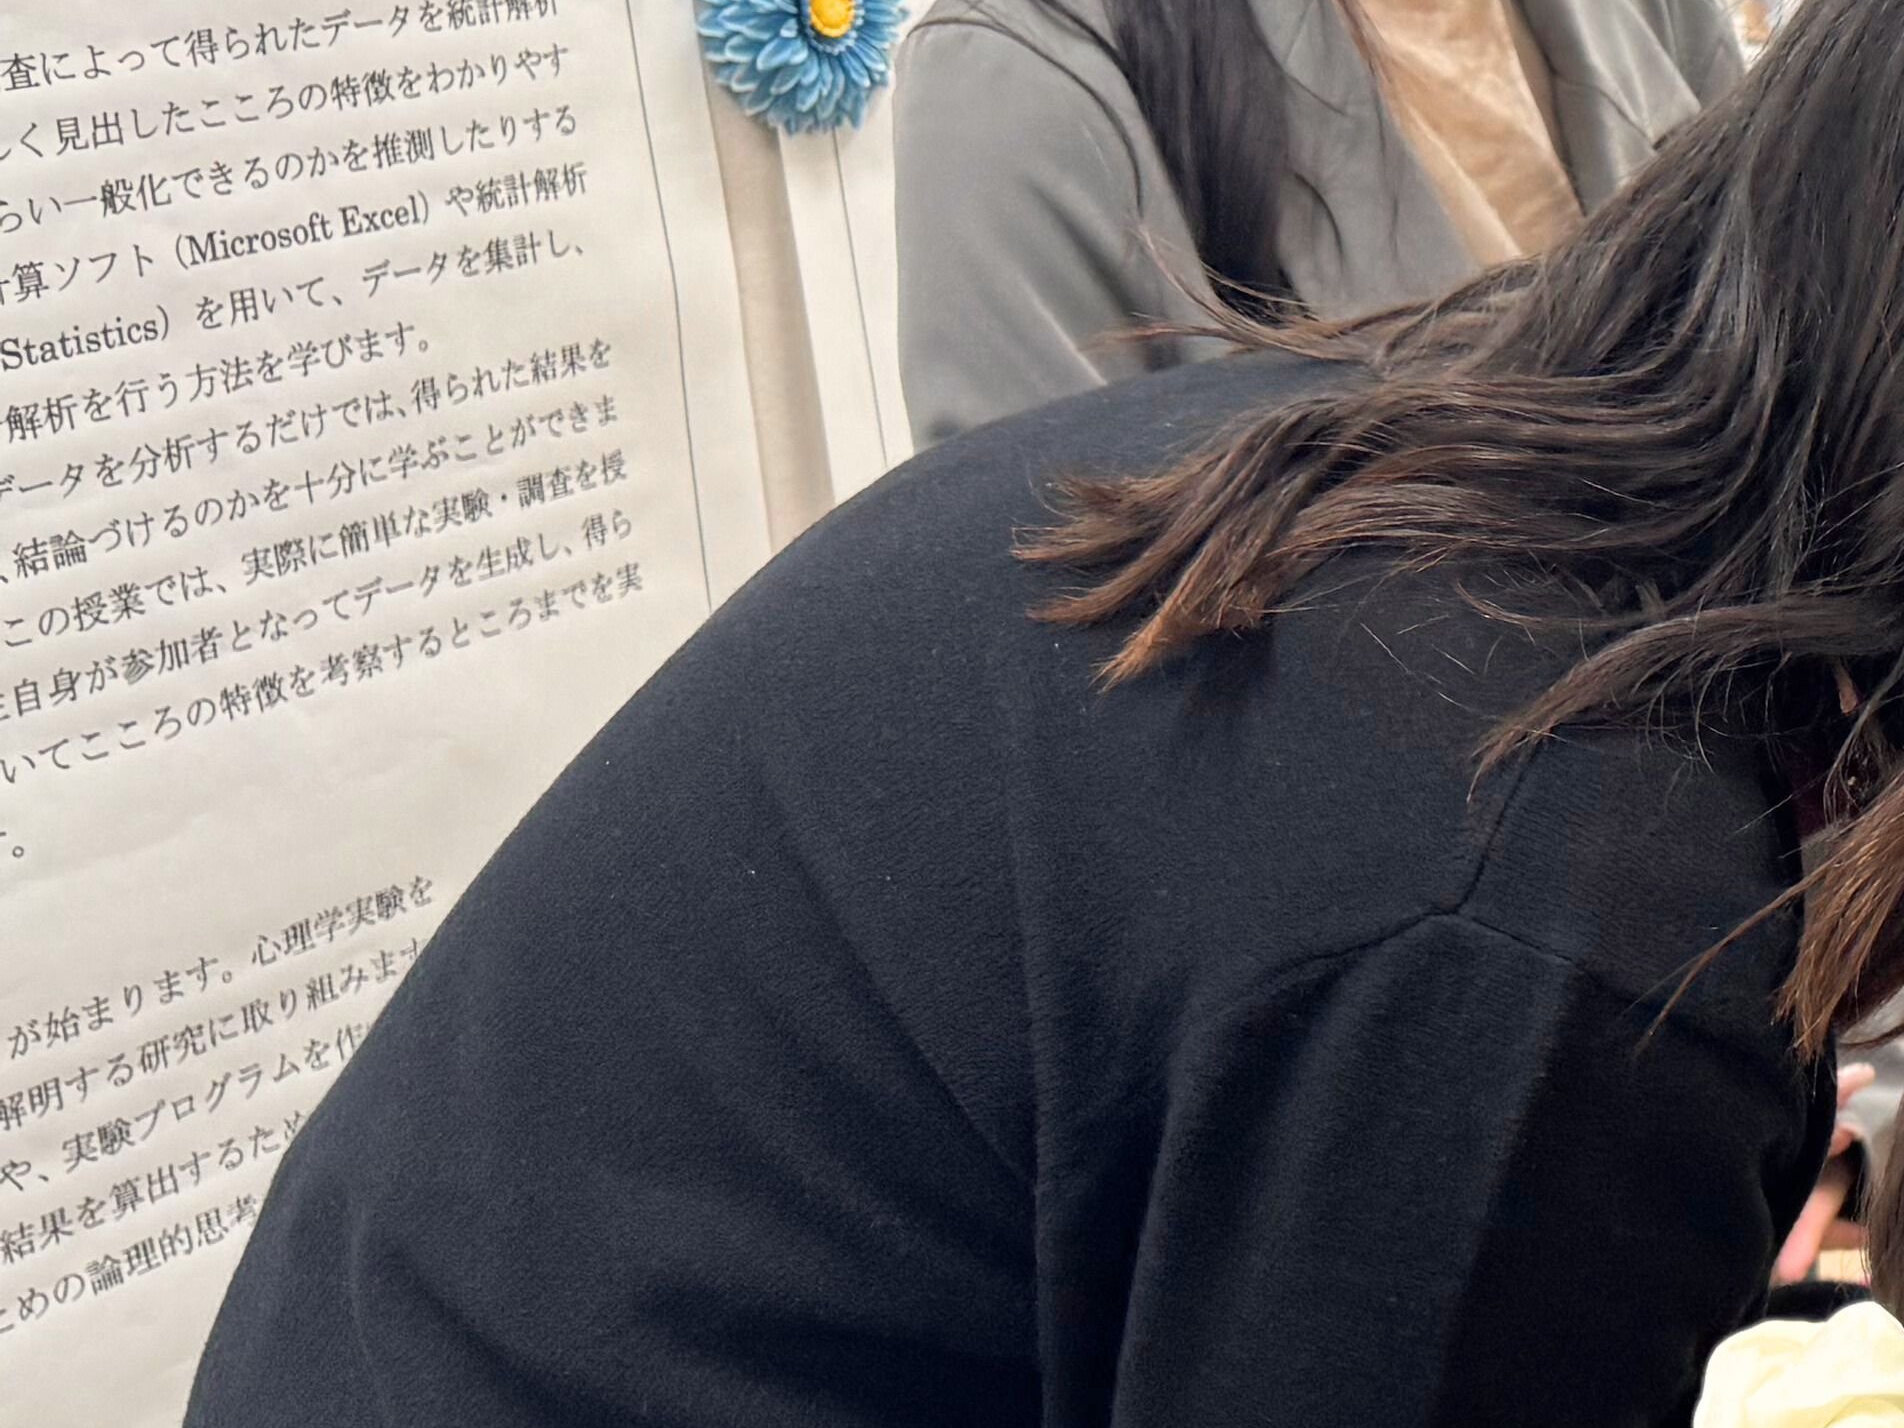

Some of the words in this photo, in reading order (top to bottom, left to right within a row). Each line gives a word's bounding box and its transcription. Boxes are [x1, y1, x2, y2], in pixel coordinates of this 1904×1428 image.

[0, 321, 429, 444] 解析を行う方法を学びます。
[0, 508, 633, 722] 自身が参加者となってデータを生成し、得ら
[0, 1022, 374, 1192] や、実験プログラムを作
[0, 1193, 259, 1334] めの論理的思考
